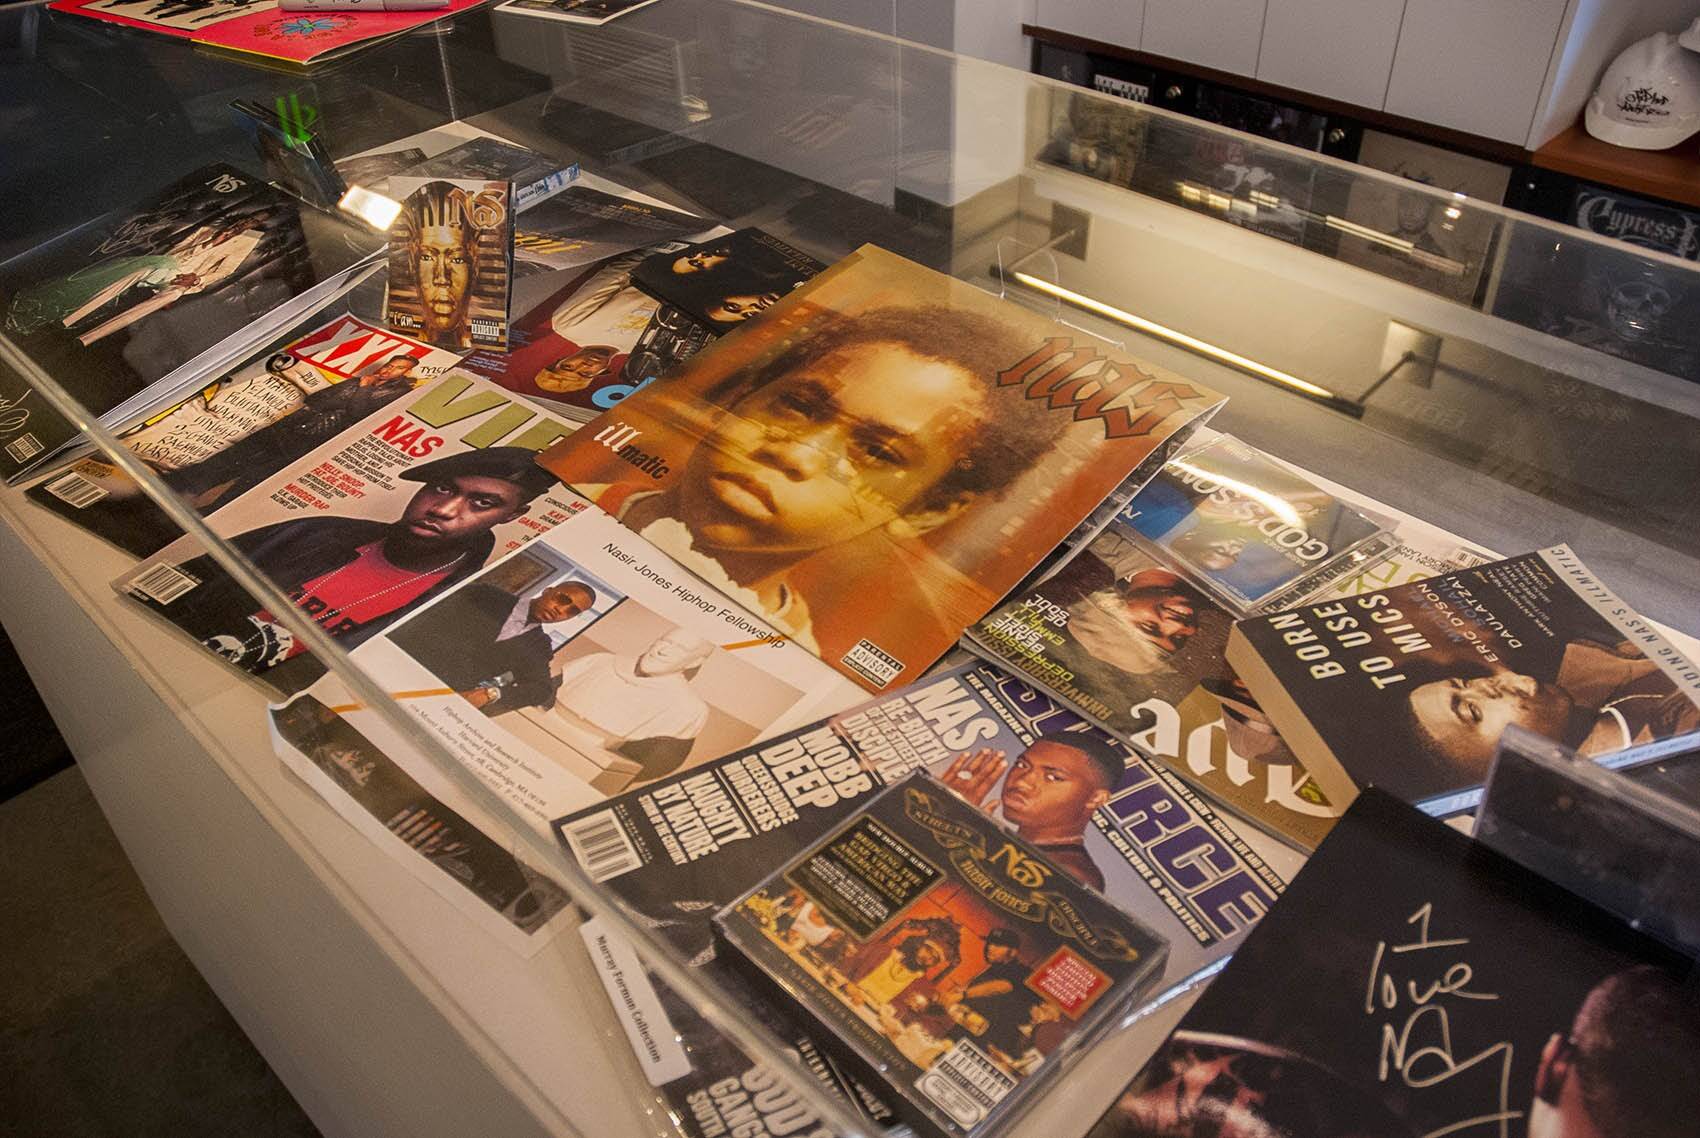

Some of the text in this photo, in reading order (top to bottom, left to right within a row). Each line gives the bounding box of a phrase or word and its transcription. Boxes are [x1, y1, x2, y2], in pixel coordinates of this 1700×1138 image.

[1576, 190, 1678, 240] Cypress
[358, 437, 381, 452] RAPPER
[378, 449, 395, 460] TALKS
[365, 450, 386, 463] LOSING
[371, 413, 446, 461] NAS
[374, 438, 414, 463] REVOLUTIONARY
[302, 472, 347, 499] INTRODUCE THEIR
[310, 467, 366, 500] FAT BOUNTY
[331, 455, 396, 493] SAVE HIP HOP FROM ITSELF
[337, 450, 366, 468] PERSONAL
[362, 465, 385, 479] MISSION
[268, 493, 289, 506] BLOWS
[282, 483, 330, 512] MURDER RAP
[286, 494, 309, 508] GARAGE
[603, 543, 787, 650] Nasir Jones Hiphop Fellowship
[1487, 569, 1504, 588] NEAL
[1519, 560, 1549, 590] COMMON
[1519, 582, 1538, 600] GREG
[1550, 547, 1613, 603] ILLMATIC
[1004, 612, 1043, 641] SIGEL
[1025, 599, 1068, 628] DE LA
[1034, 593, 1071, 620] SOUL
[1312, 602, 1373, 648] USE
[1357, 594, 1433, 654] MICS
[1417, 583, 1499, 664] ERIC DYSON
[1447, 577, 1523, 649] DAULATZAI
[1502, 588, 1536, 618] ANTHONY
[1612, 607, 1658, 643] NAS'S
[859, 640, 902, 671] PARENTAL
[984, 623, 1075, 682] DEPRESSION
[991, 618, 1046, 655] BEANIE
[1268, 612, 1346, 680] BORN
[852, 648, 895, 680] ADVISORY
[1359, 656, 1407, 690] TO
[1015, 655, 1113, 721] ANNIVERSARY
[880, 698, 950, 767] RE-BIRTH
[905, 677, 1000, 751] NAS
[797, 726, 875, 800] MOBB
[840, 713, 911, 784] DISCIPLE
[721, 760, 782, 832] MURDERERS
[741, 754, 800, 824] QUEENSBRIDGE
[759, 737, 840, 809] DEEP
[652, 782, 720, 861] BY NATURE
[681, 771, 753, 847] NAUGHTY
[965, 673, 984, 689] THE
[980, 687, 1026, 734] MAGAZINE
[1108, 831, 1151, 881] CULTURE
[1158, 885, 1211, 943] POLITICS
[867, 823, 934, 877] NEW DOUBLE ALBUM
[1190, 798, 1211, 816] CREW
[1232, 841, 1250, 856] LIFE
[1244, 852, 1263, 868] AND
[1257, 865, 1283, 890] DEATH
[597, 935, 662, 1065] Murray Forman Collection
